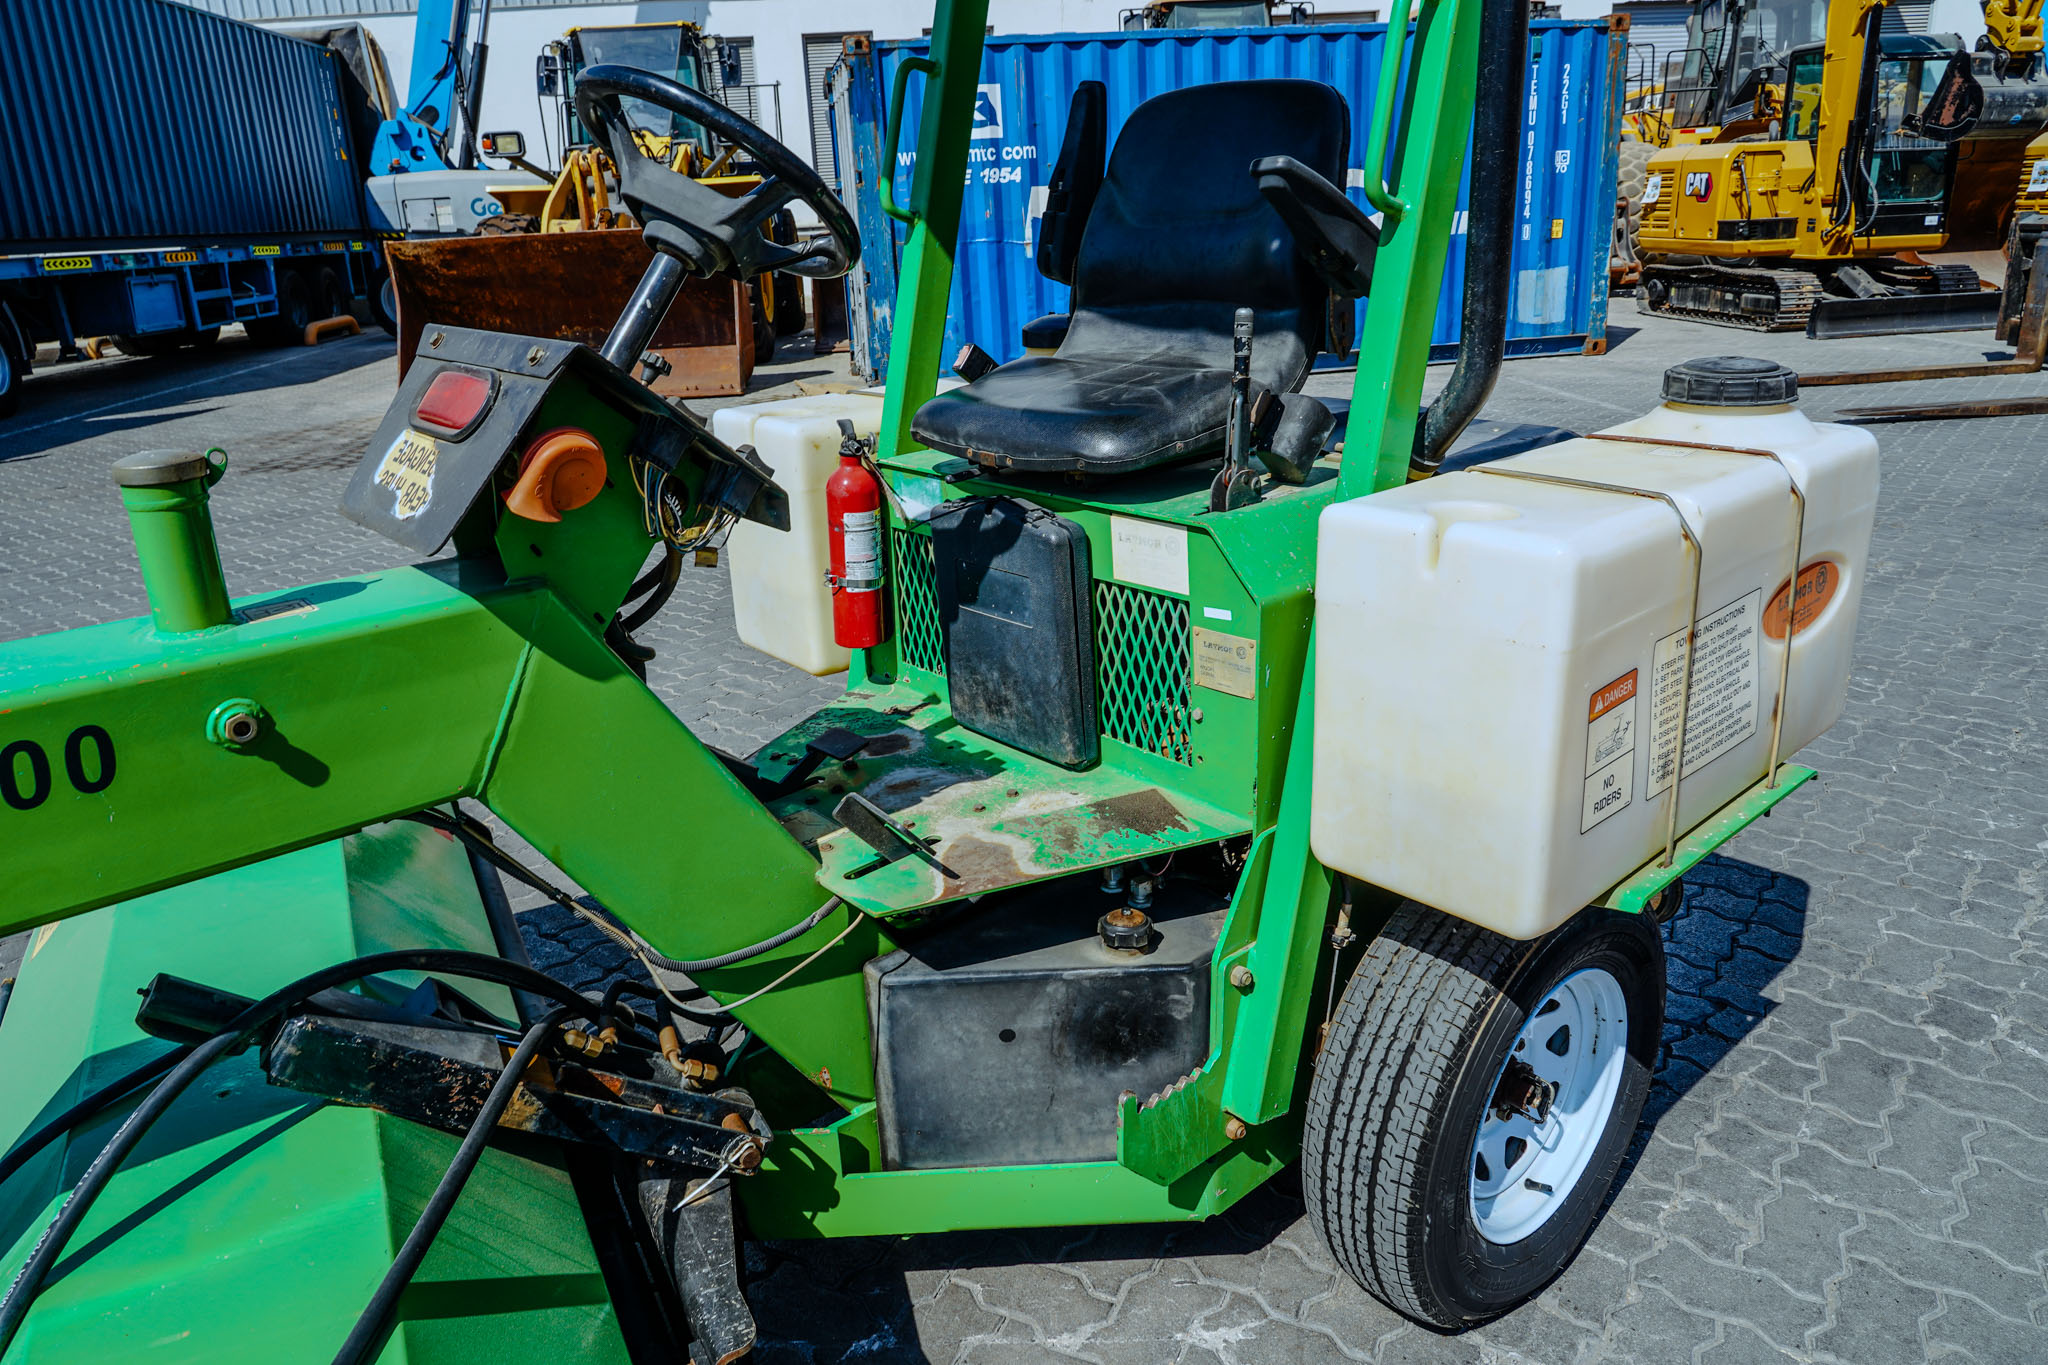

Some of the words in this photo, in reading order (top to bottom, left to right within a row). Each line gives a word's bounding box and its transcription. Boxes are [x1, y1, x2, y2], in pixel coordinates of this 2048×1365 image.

[1528, 65, 1539, 125] TEMU
[1561, 64, 1571, 124] 22G1
[980, 166, 1021, 184] 1954
[1523, 131, 1535, 219] 078694
[1685, 172, 1710, 197] CAT
[471, 197, 504, 216] Ge
[1703, 604, 1745, 634] INSTRUCTIONS
[1718, 640, 1729, 650] SHUT
[1661, 657, 1677, 671] STEER
[1695, 662, 1707, 675] VALVE
[1704, 667, 1717, 680] HITCH
[1604, 679, 1633, 707] DANGER
[1660, 701, 1678, 716] ATTACH
[1716, 665, 1740, 683] ELECTRICAL
[1690, 696, 1705, 710] CABLE
[1688, 709, 1700, 722] REAR
[1702, 721, 1717, 735] BRAKE
[1718, 710, 1735, 726] BEFORE
[1702, 733, 1714, 746] LIGHT
[1725, 717, 1742, 732] PROPER
[1658, 737, 1672, 751] TURN
[1696, 744, 1710, 759] LOCAL
[1712, 736, 1723, 749] CODE
[1603, 774, 1615, 791] NO
[1593, 787, 1622, 815] RIDERS
